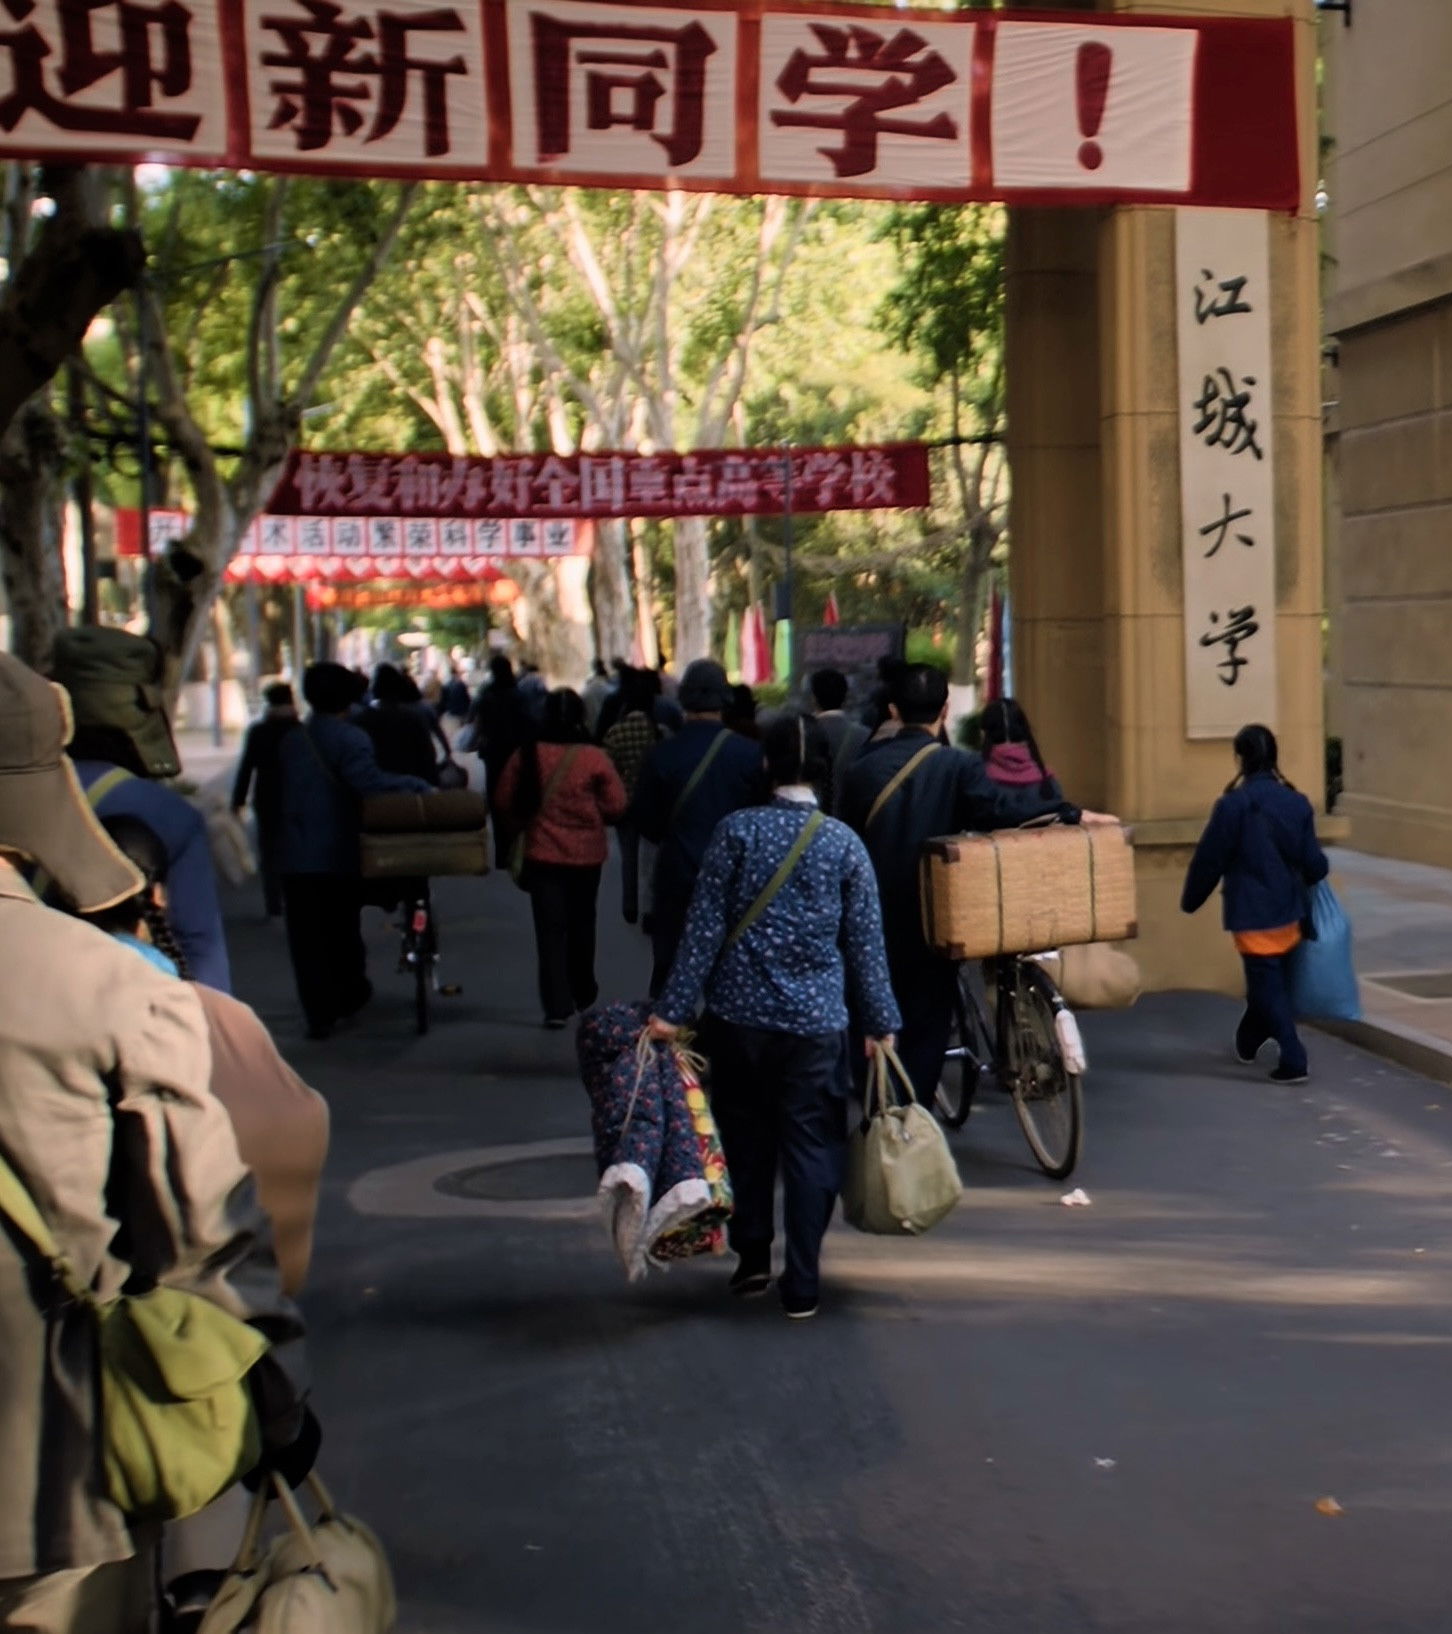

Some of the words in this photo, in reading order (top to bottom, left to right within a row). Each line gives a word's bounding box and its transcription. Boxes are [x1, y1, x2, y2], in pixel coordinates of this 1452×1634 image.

[152, 517, 569, 549] 开术活动繁荣科学事业
[1193, 268, 1263, 686] 江城大学
